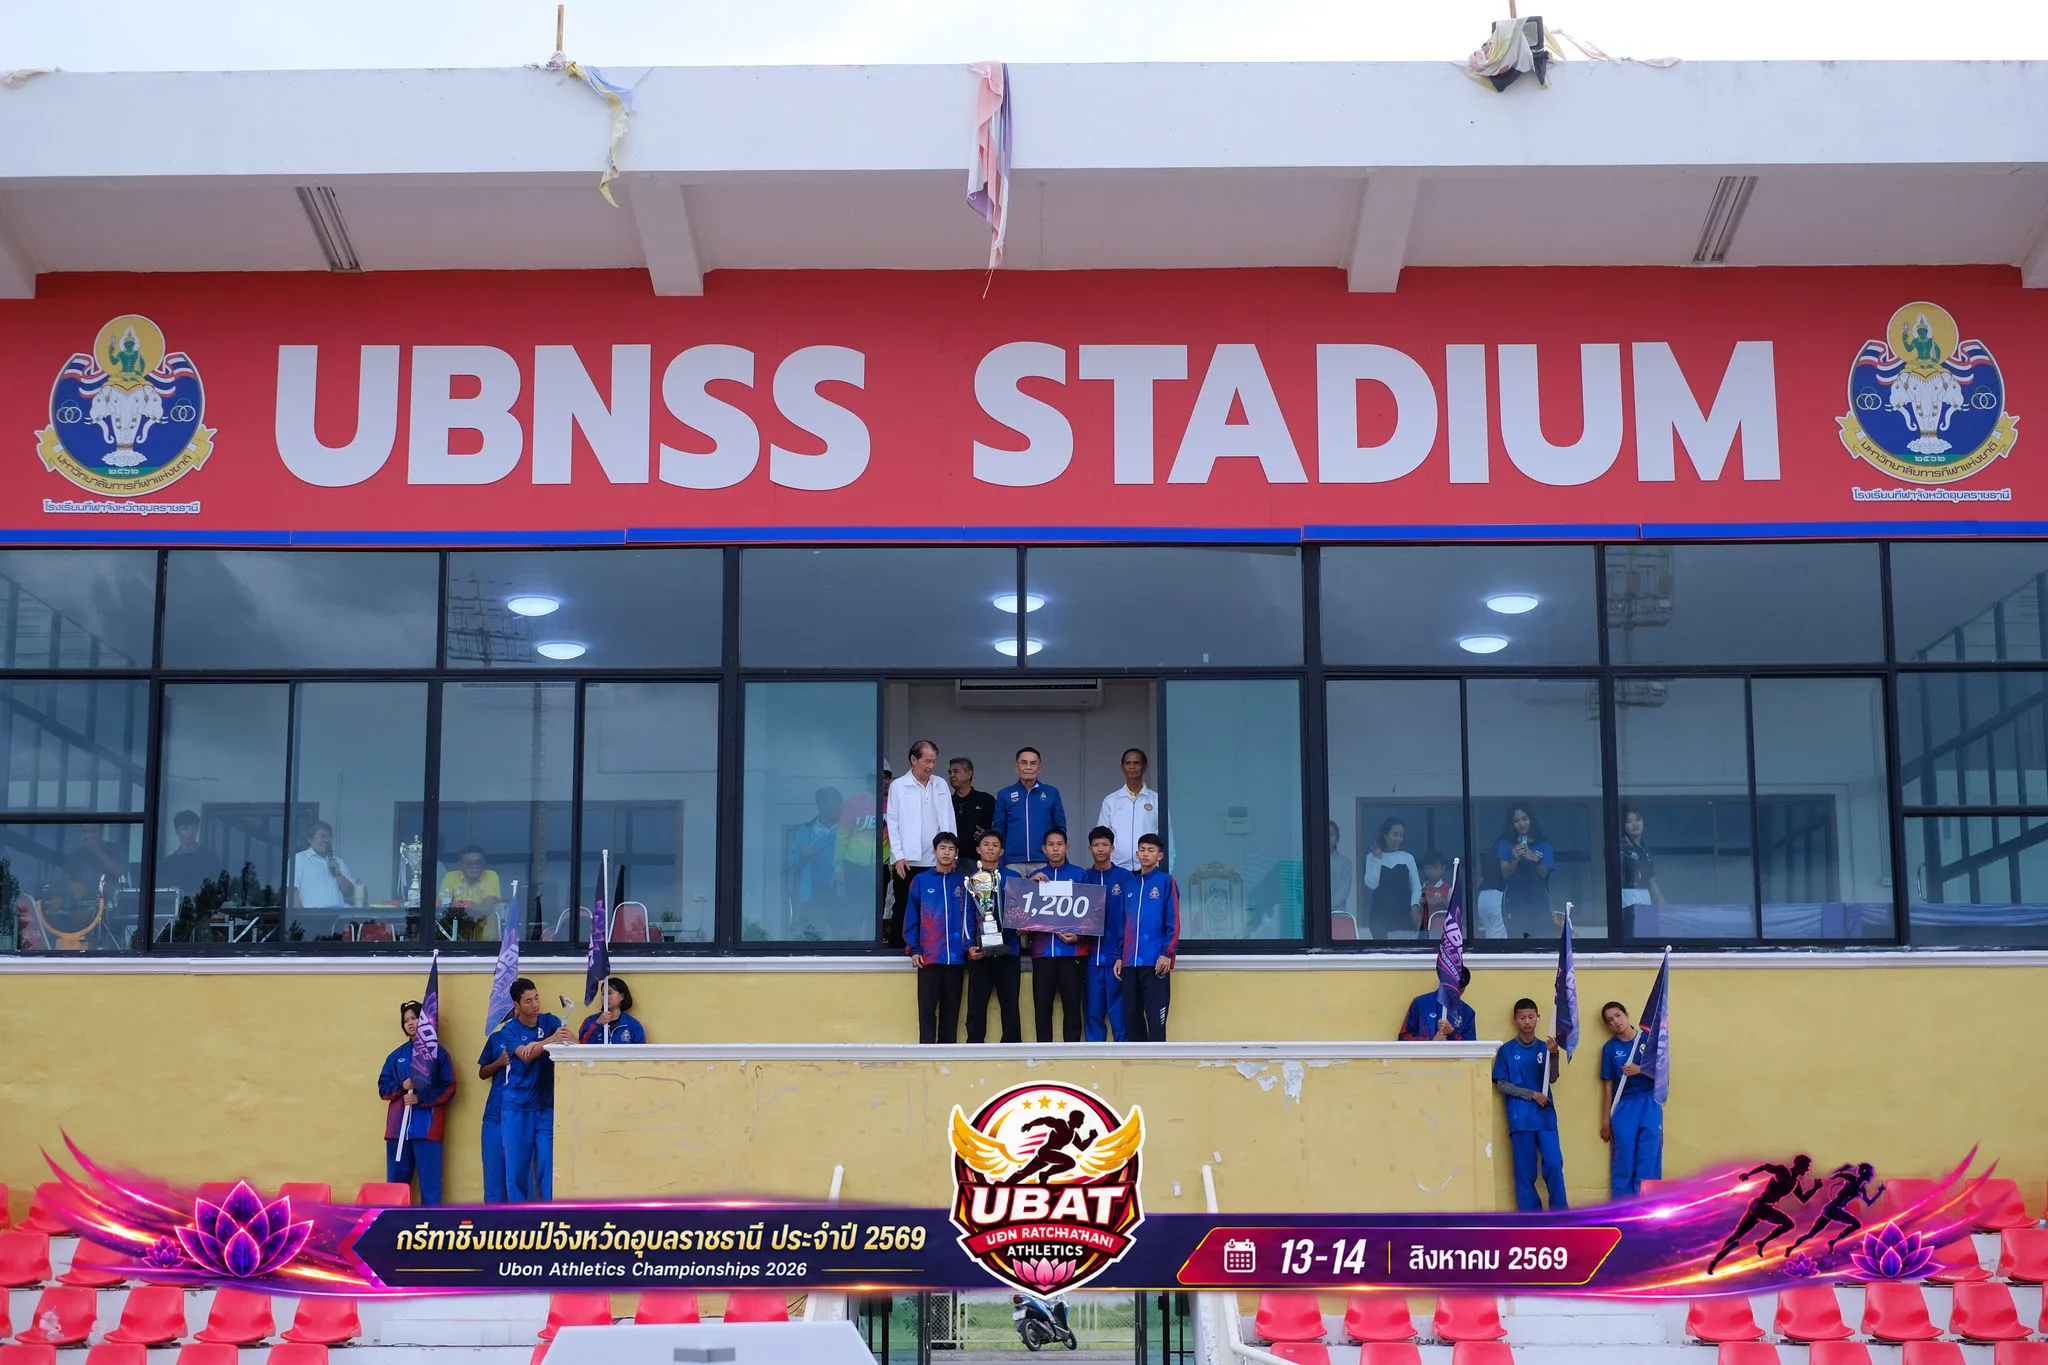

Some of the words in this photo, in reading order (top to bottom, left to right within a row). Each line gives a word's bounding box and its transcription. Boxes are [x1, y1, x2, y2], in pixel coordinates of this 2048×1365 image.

[275, 343, 872, 491] UBNSS
[972, 340, 1782, 487] STADIUM
[56, 454, 192, 491] มหาวิทยาลัยการกีฬาแห่งชาติ
[1861, 441, 1998, 478] มหาวิทยาลัยการกีฬาแห่งชาติ
[44, 501, 199, 514] โรงเรียนกีฬาจังหวัดอุบลราชธานี
[1854, 488, 2010, 502] โรงเรียนกีฬาจังหวัดอุบลราชธานี
[1022, 891, 1089, 918] 1,200
